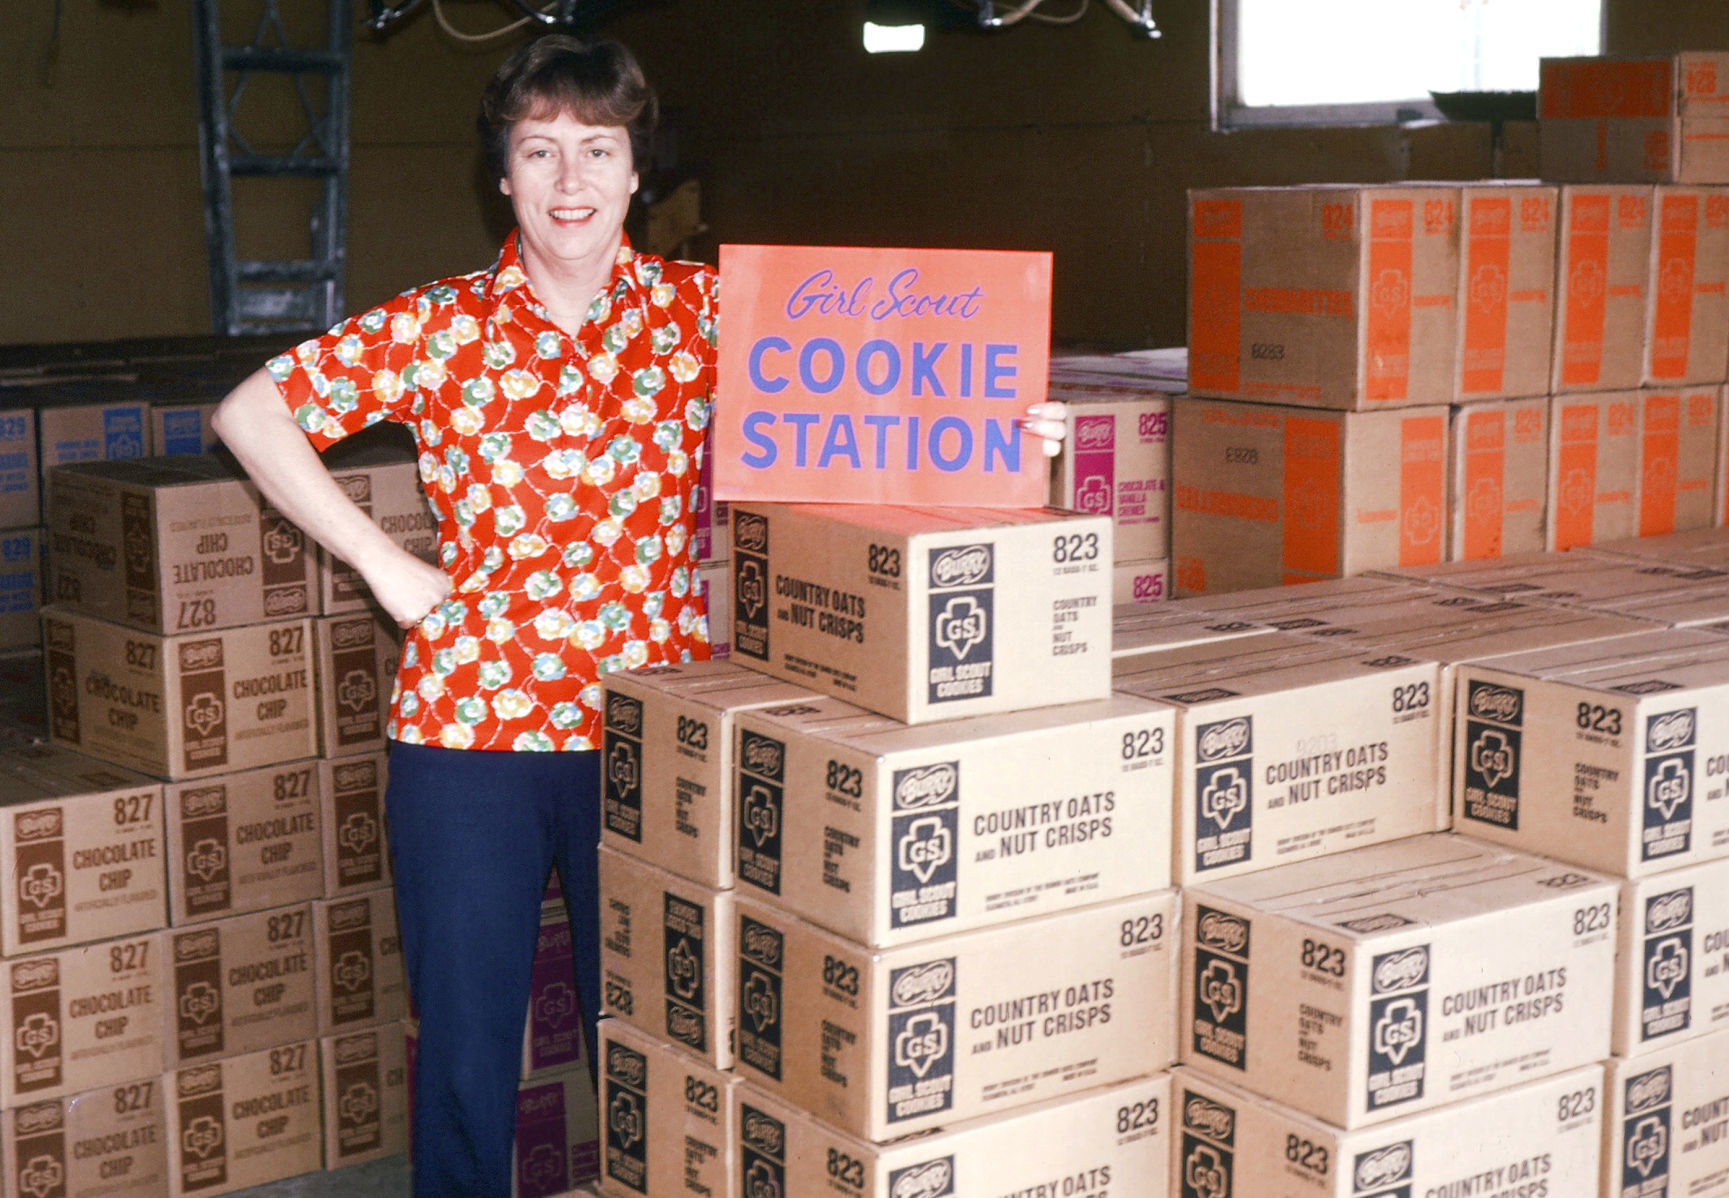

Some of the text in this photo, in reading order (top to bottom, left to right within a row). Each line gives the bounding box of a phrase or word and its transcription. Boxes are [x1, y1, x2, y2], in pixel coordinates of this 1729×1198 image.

[786, 268, 985, 321] Girl Scout
[748, 336, 1018, 399] COOKIE
[1138, 411, 1168, 437] 825
[740, 410, 1022, 473] STATION
[1083, 492, 1105, 508] GS
[381, 513, 434, 534] CHOCOL
[197, 532, 228, 554] CHIP
[1053, 532, 1099, 564] 823
[174, 555, 254, 584] CHOCOLATE
[868, 543, 900, 578] 823
[776, 573, 866, 619] COUNTRY OATS
[1132, 573, 1163, 600] 825
[177, 599, 216, 630] 827
[1053, 596, 1098, 611] COUNTRY
[1053, 610, 1079, 624] OATS
[790, 602, 816, 633] NUT
[818, 610, 865, 645] CRISPS
[947, 617, 977, 641] GS
[1052, 630, 1073, 644] NUT
[125, 640, 157, 671] 827
[268, 626, 304, 657] 827
[1052, 641, 1088, 657] CRISPS
[234, 668, 308, 700] CHOCOLATE
[1392, 681, 1430, 713] 823
[191, 705, 216, 724] GS
[257, 699, 287, 722] CHIP
[1576, 701, 1622, 736] 823
[676, 715, 708, 750] 823
[1122, 727, 1165, 760] 823
[1266, 741, 1389, 786] COUNTRY OATS
[1480, 748, 1507, 770] GS
[273, 770, 312, 800] 827
[826, 759, 863, 799] 823
[1289, 779, 1322, 806] NUT
[1327, 765, 1387, 796] CRISPS
[1658, 779, 1684, 800] GS
[114, 793, 154, 826] 827
[974, 791, 1116, 836] COUNTRY OATS
[1211, 787, 1240, 811] GS
[236, 812, 315, 845] CHOCOLATE
[1000, 831, 1038, 859] NUT
[1045, 816, 1113, 849] CRISPS
[73, 838, 156, 871] CHOCOLATE
[195, 851, 219, 870] GS
[260, 844, 293, 866] CHIP
[909, 838, 942, 863] GS
[28, 876, 53, 896] GS
[99, 868, 132, 892] CHIP
[267, 911, 306, 943] 827
[1121, 913, 1163, 948] 823
[1573, 902, 1611, 936] 823
[110, 941, 150, 973] 827
[229, 952, 308, 985] CHOCOLATE
[1302, 938, 1346, 978] 823
[823, 954, 860, 996] 823
[69, 985, 152, 1019] CHOCOLATE
[253, 984, 286, 1008] CHIP
[970, 977, 1115, 1030] COUNTRY OATS
[1442, 966, 1568, 1017] COUNTRY OATS
[95, 1016, 129, 1040] CHIP
[996, 1021, 1037, 1050] NUT
[1043, 1003, 1112, 1037] CRISPS
[1464, 1009, 1498, 1037] NUT
[1504, 992, 1565, 1027] CRISPS
[26, 1026, 50, 1044] GS
[906, 1031, 939, 1058] GS
[1385, 1019, 1415, 1045] GS
[269, 1044, 307, 1076] 827
[114, 1081, 154, 1115] 827
[232, 1085, 310, 1120] CHOCOLATE
[685, 1074, 719, 1113] 823
[1557, 1087, 1596, 1123] 823
[256, 1116, 289, 1139] CHIP
[1116, 1098, 1159, 1133] 823
[1681, 1095, 1729, 1131] COUNT
[74, 1125, 157, 1160] CHOCOLATE
[1285, 1133, 1329, 1176] 823
[29, 1167, 54, 1187] GS
[100, 1155, 133, 1180] CHIP
[827, 1146, 865, 1190] 823
[1062, 1164, 1112, 1197] OATS
[1508, 1152, 1552, 1184] OATS
